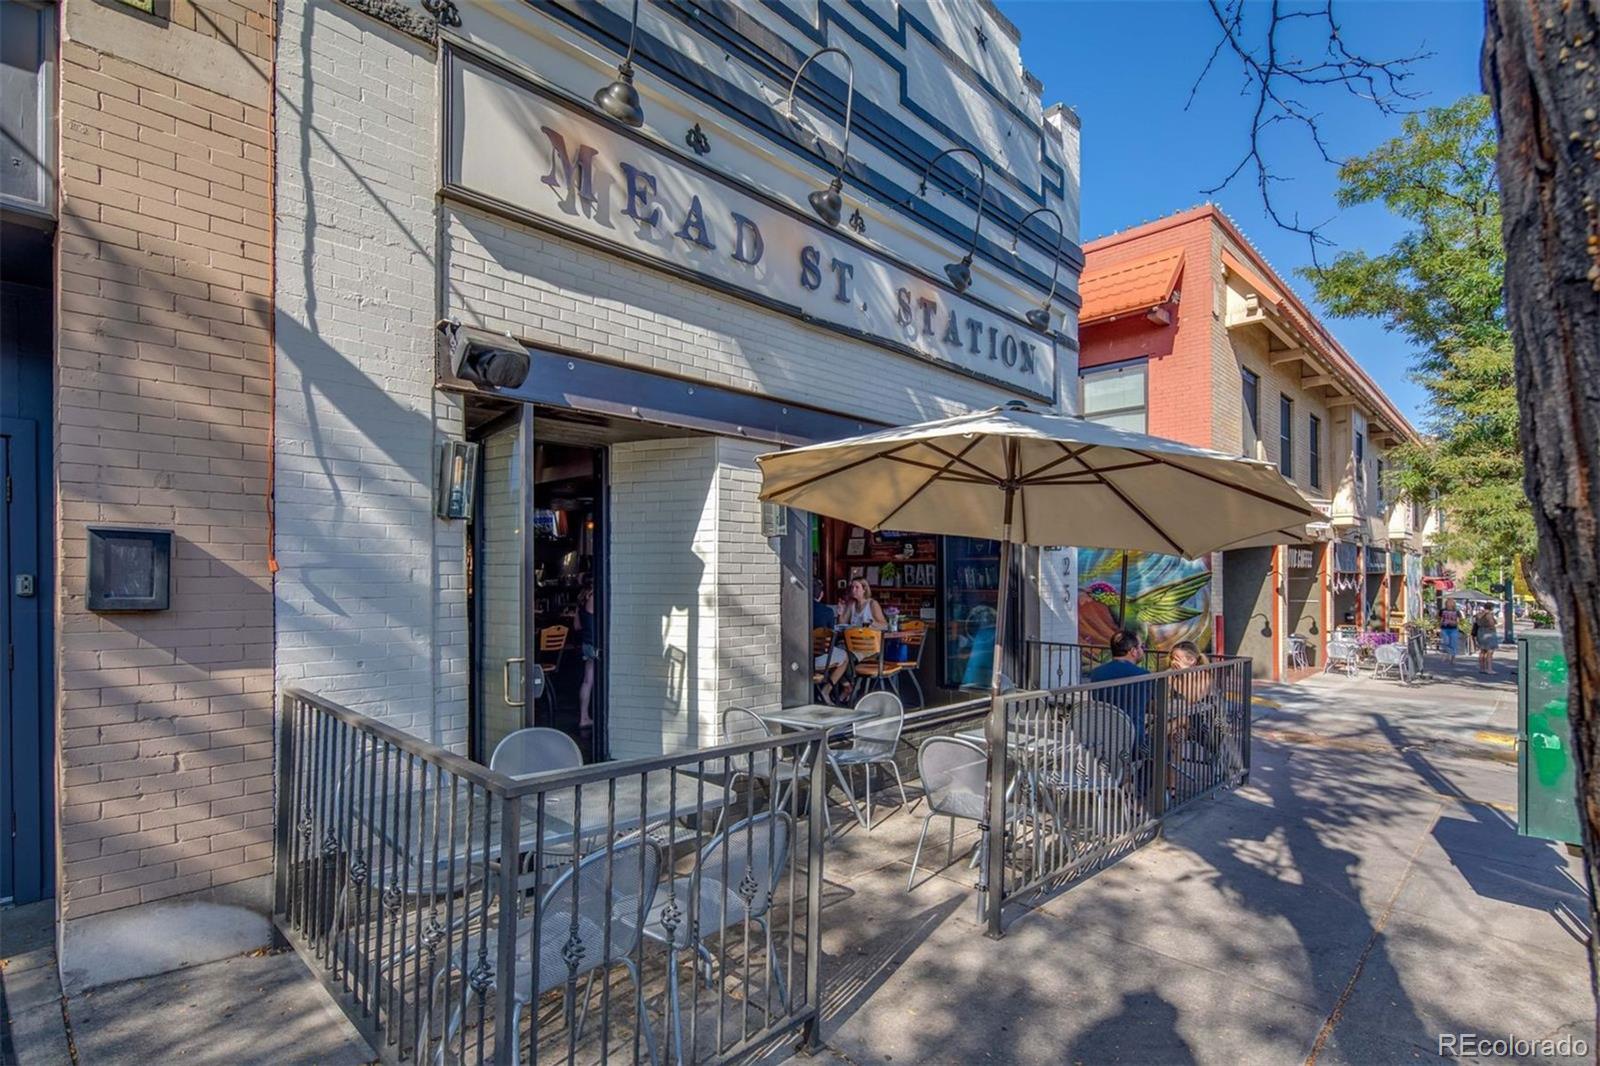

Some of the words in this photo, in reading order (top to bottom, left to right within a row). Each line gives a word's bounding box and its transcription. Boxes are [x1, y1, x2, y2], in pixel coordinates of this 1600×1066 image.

[541, 126, 764, 266] MEAD
[801, 245, 868, 312] ST.
[897, 287, 1036, 376] STATION
